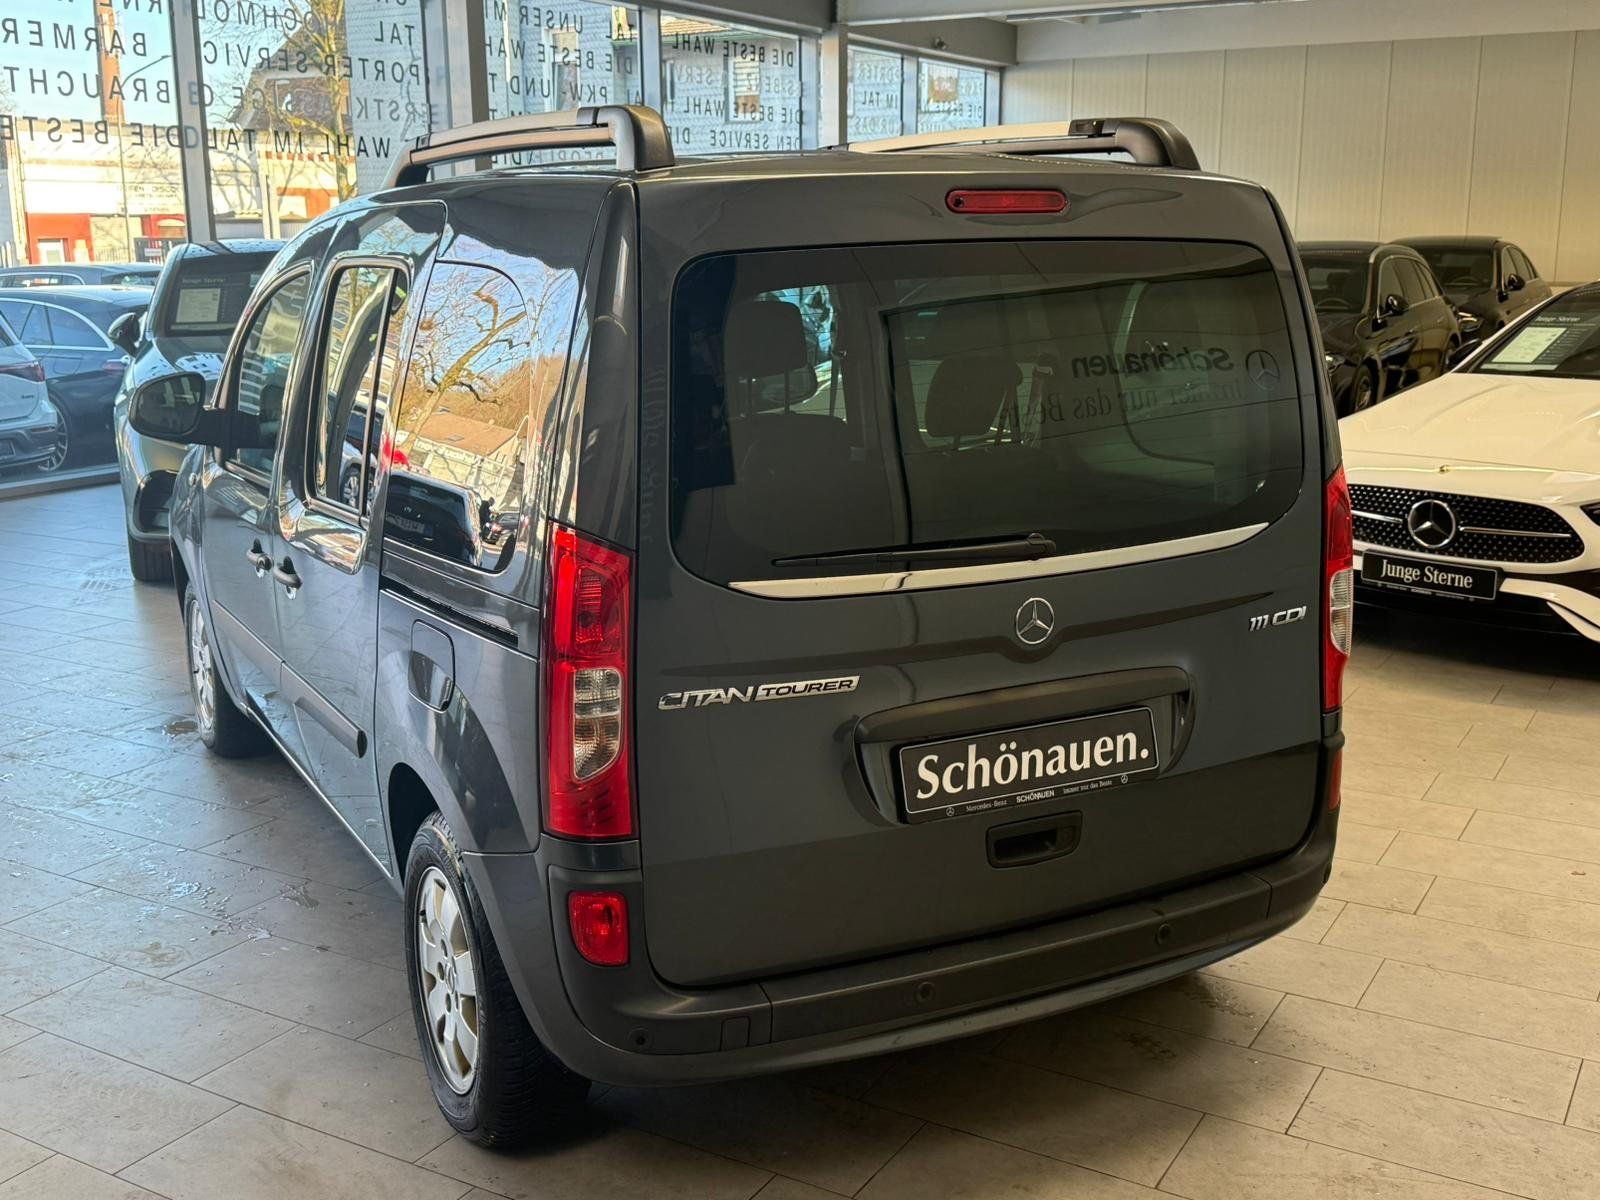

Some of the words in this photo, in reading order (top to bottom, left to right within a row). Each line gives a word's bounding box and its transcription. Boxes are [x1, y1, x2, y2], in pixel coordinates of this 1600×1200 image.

[1380, 558, 1421, 583] Junge
[1423, 565, 1473, 589] Sterne
[1249, 614, 1269, 632] 111
[1272, 605, 1307, 626] CDI
[657, 685, 754, 711] CITAN
[760, 679, 854, 698] TOURER
[915, 730, 1150, 801] Schönauen.
[1016, 789, 1055, 804] SCHÖNAUEN
